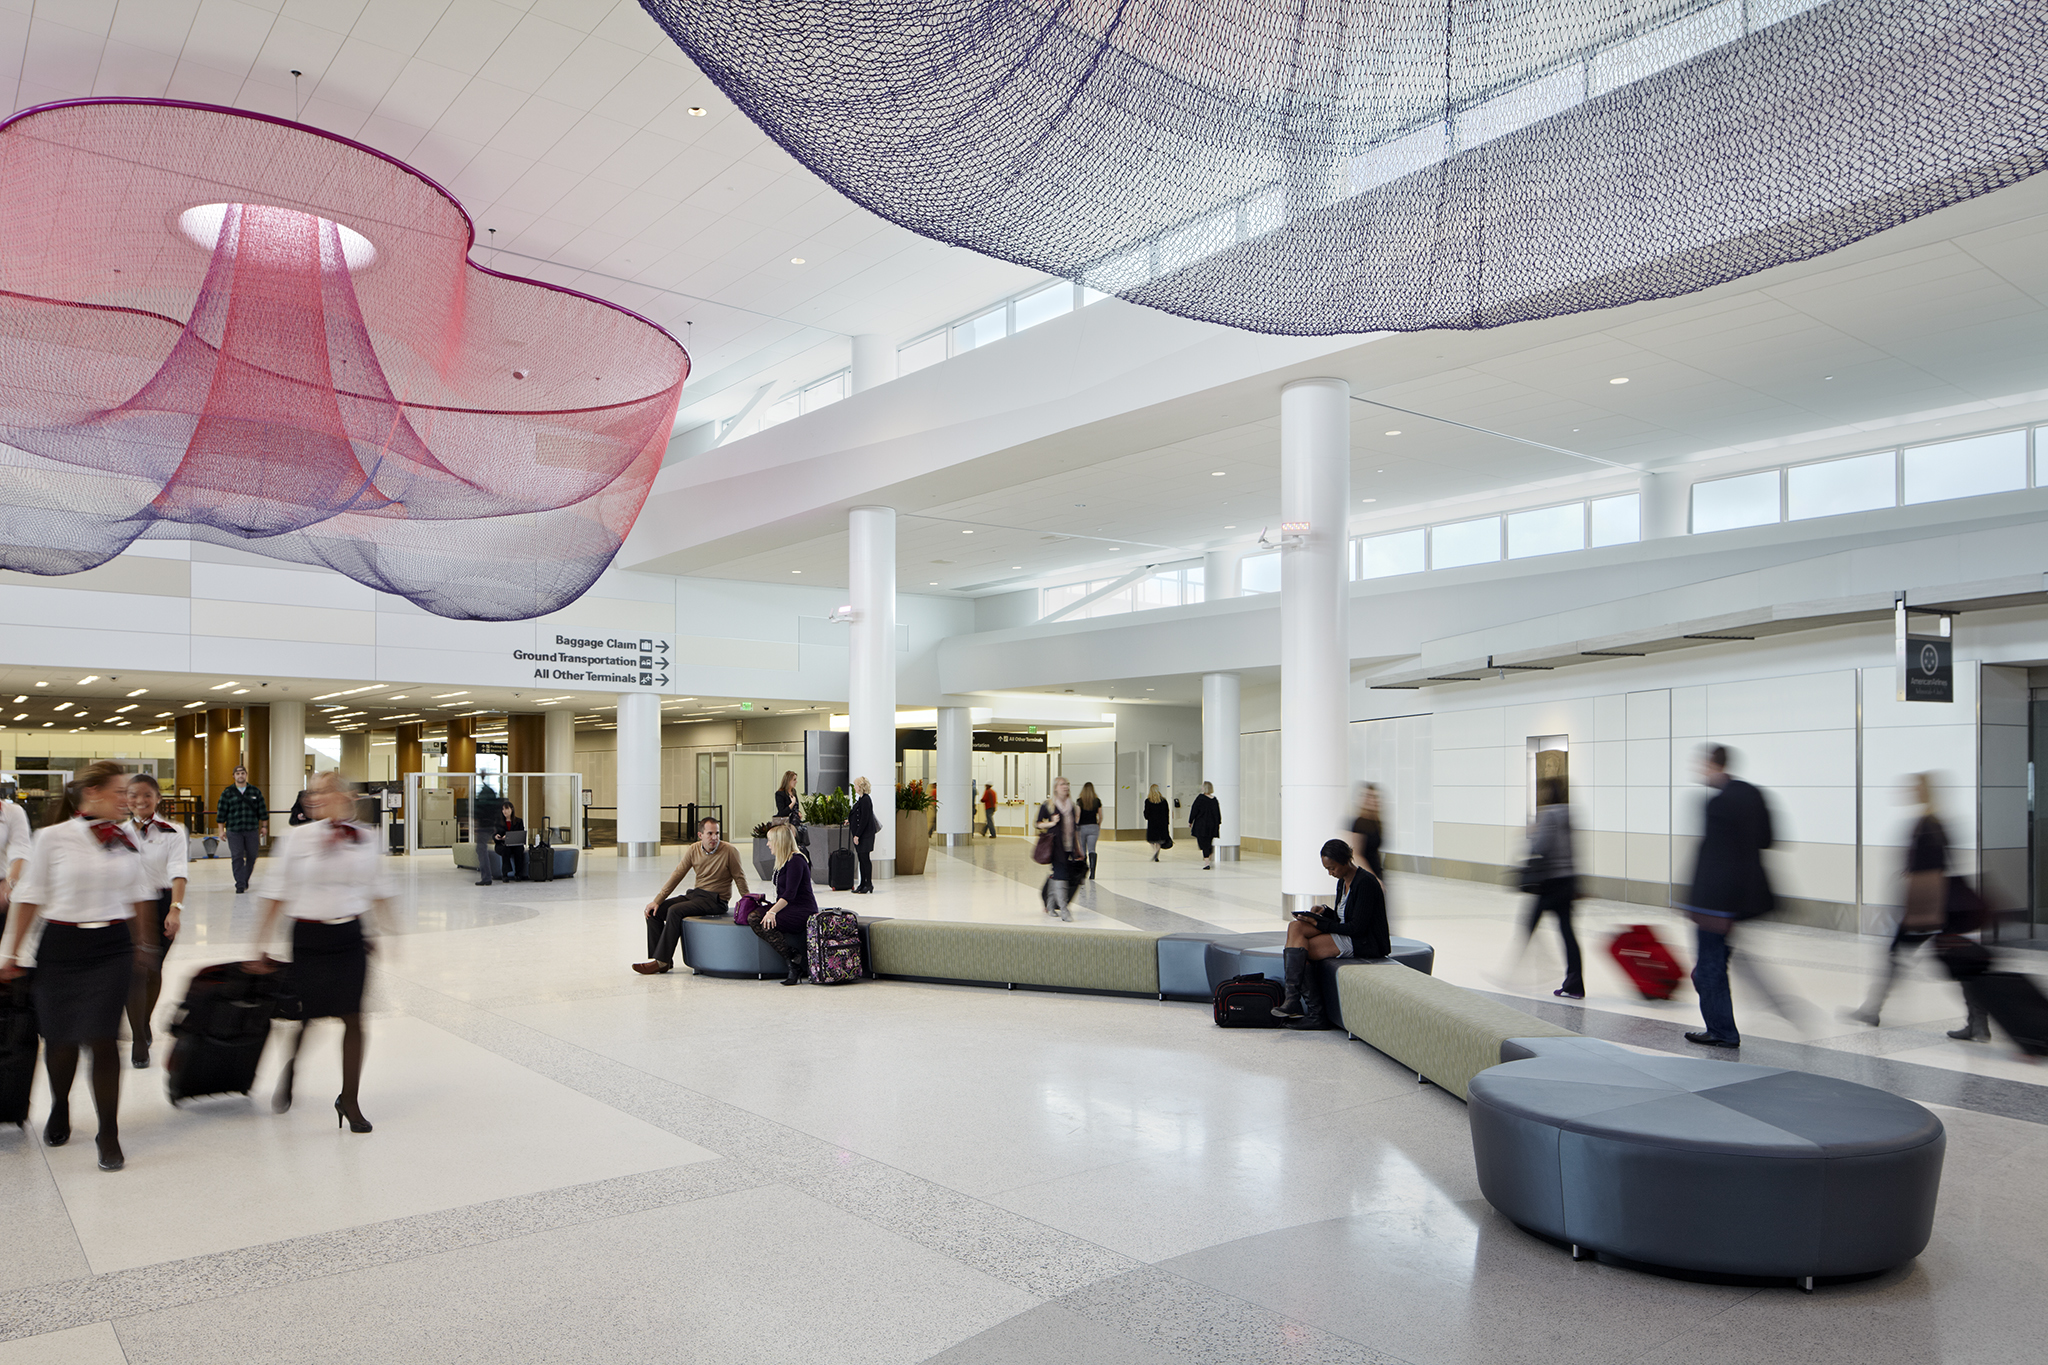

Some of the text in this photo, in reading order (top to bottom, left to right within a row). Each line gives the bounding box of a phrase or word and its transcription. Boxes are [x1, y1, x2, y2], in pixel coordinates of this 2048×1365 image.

[556, 635, 636, 650] Baggage Claim
[513, 649, 637, 667] Ground Transportation
[534, 669, 636, 684] All Other Terminals
